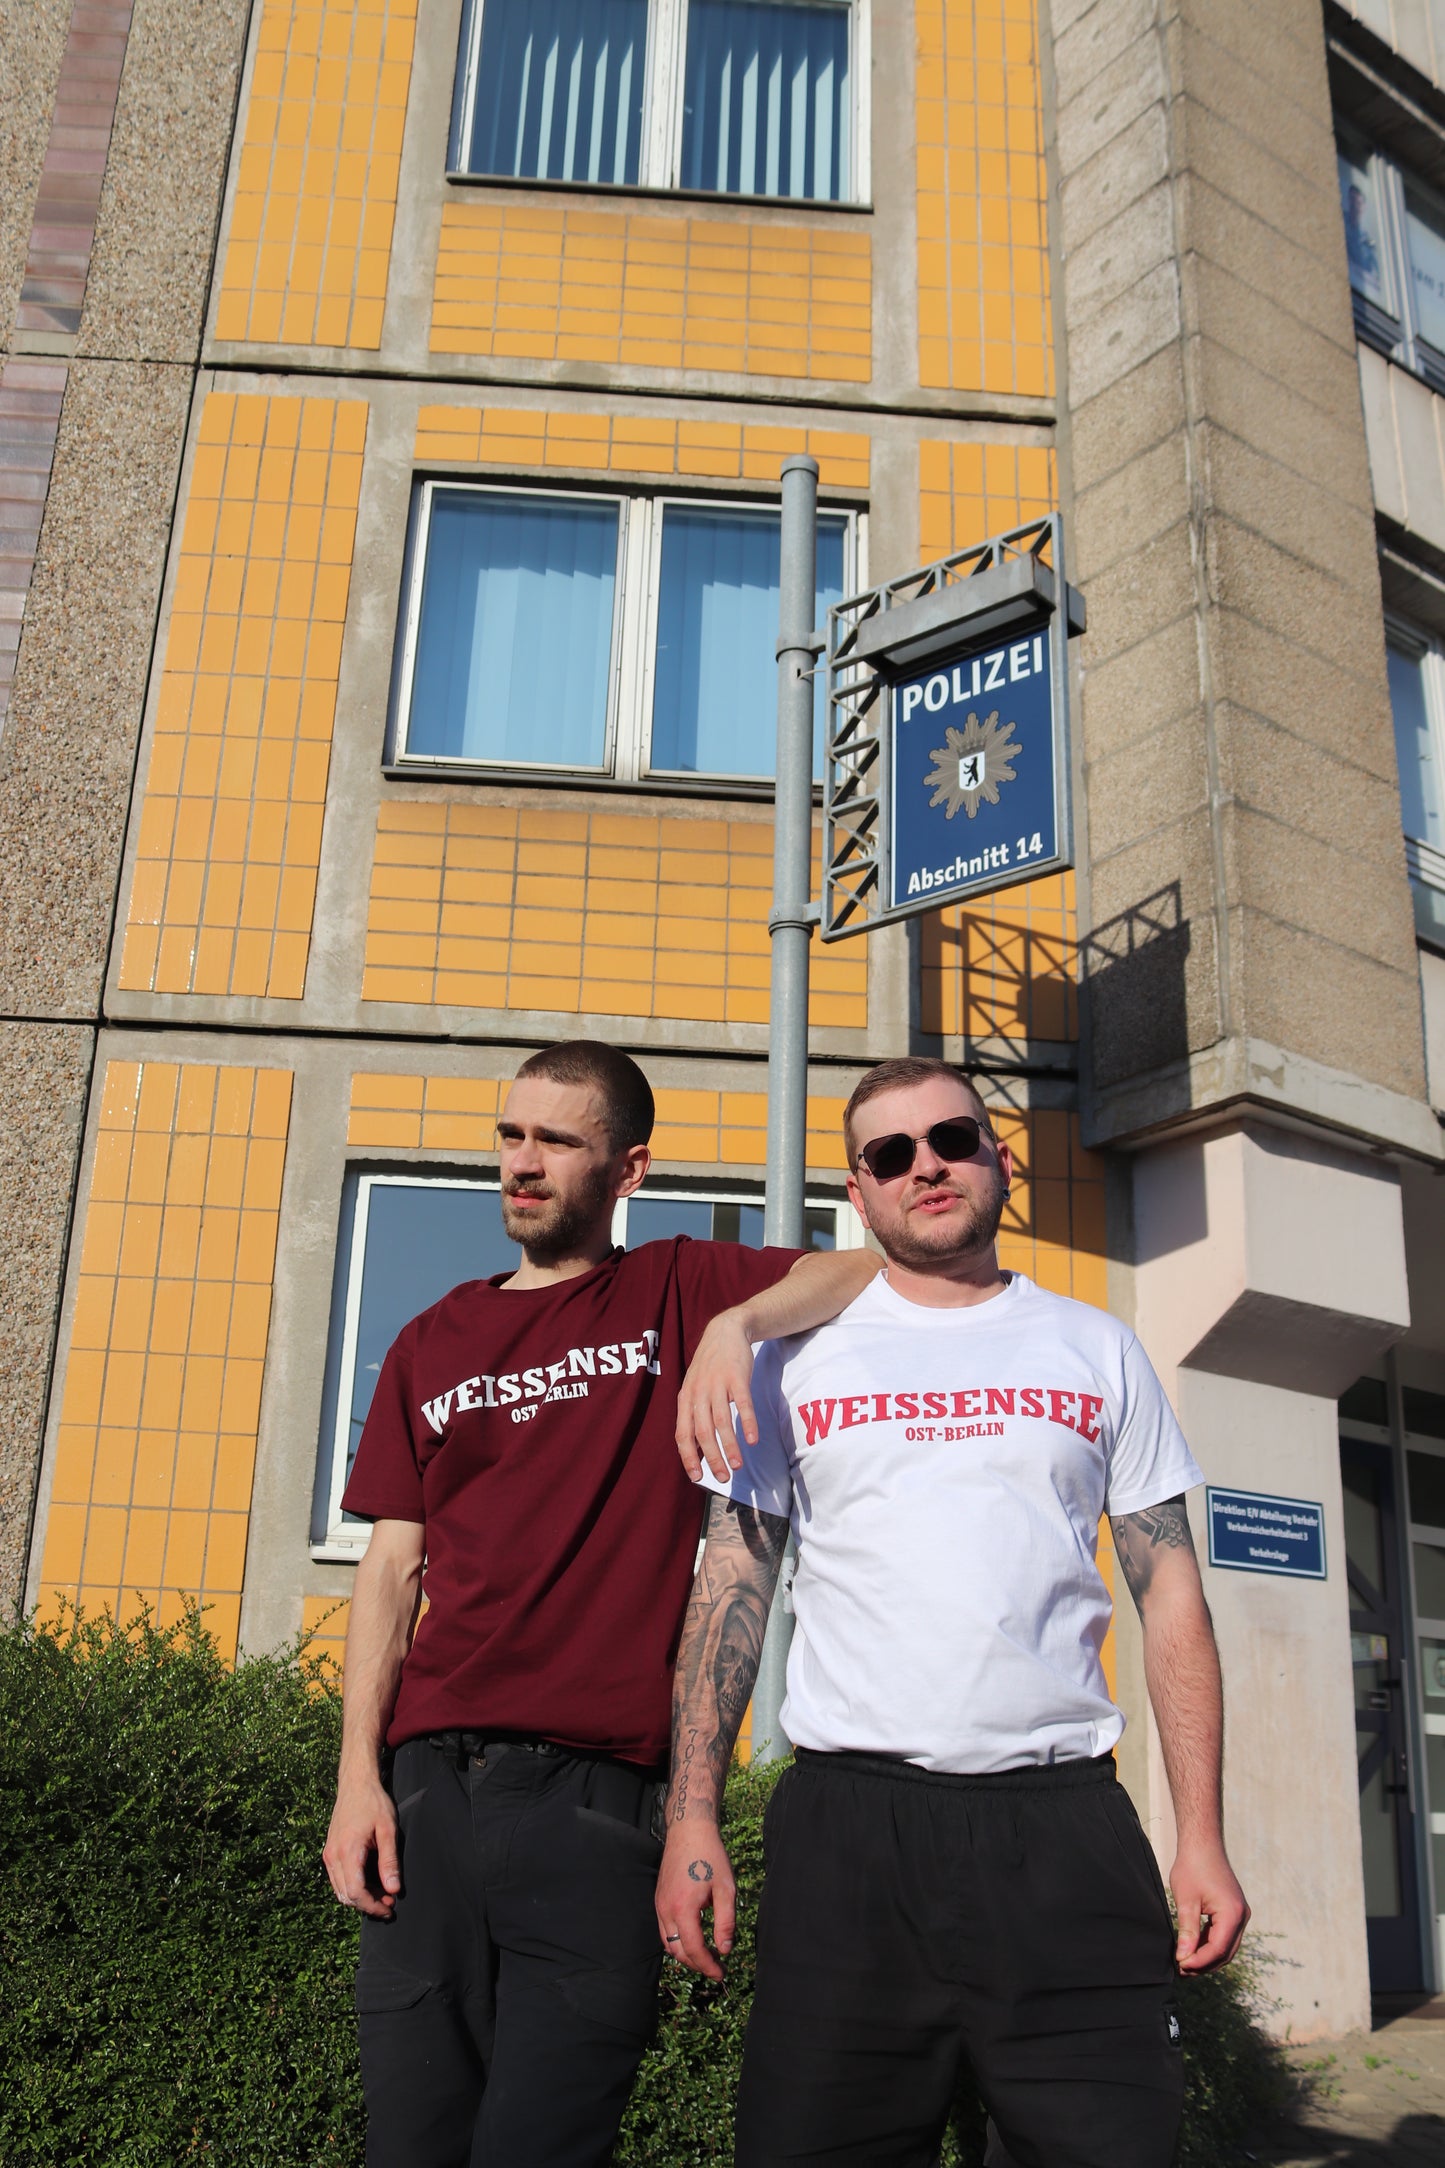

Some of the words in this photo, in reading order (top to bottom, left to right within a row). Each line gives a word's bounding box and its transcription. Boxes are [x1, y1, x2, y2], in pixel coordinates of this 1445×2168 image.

[902, 636, 1043, 722] POLIZEI
[907, 843, 1009, 894] Abschnitt
[1016, 832, 1043, 860] 14
[421, 1329, 661, 1435] WEISSENSEE
[798, 1388, 1104, 1446] WEISSENSEE
[905, 1422, 1004, 1441] OST-BERLIN
[1213, 1502, 1247, 1516] Direktion
[1259, 1509, 1292, 1526] Abteilung
[1292, 1514, 1318, 1527] Verkehr
